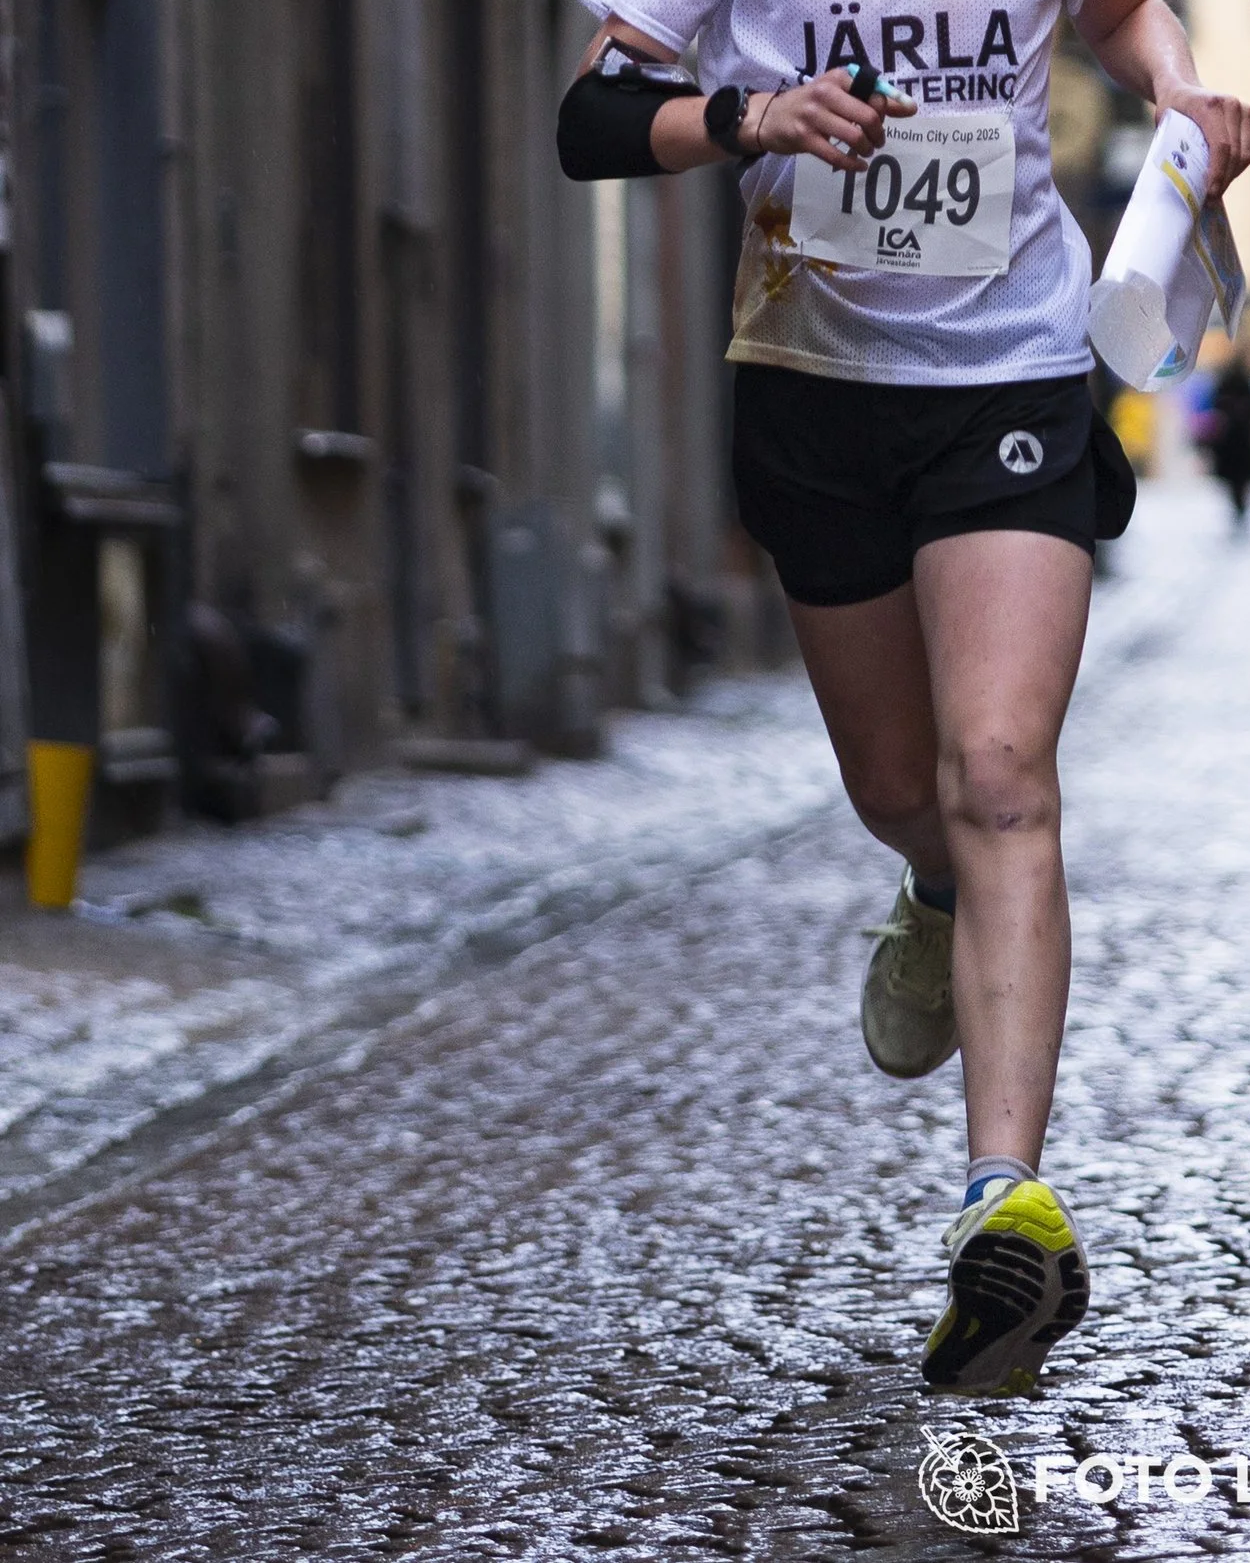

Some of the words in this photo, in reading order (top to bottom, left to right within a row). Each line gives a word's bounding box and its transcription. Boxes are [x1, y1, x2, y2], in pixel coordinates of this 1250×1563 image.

[796, 2, 1018, 75] JÄRLA
[888, 73, 1017, 103] TERING
[885, 126, 923, 142] kholm
[927, 130, 948, 145] City
[952, 130, 973, 144] Cup
[976, 128, 1000, 141] 2025
[832, 153, 980, 226] 1049
[878, 226, 921, 251] ICA
